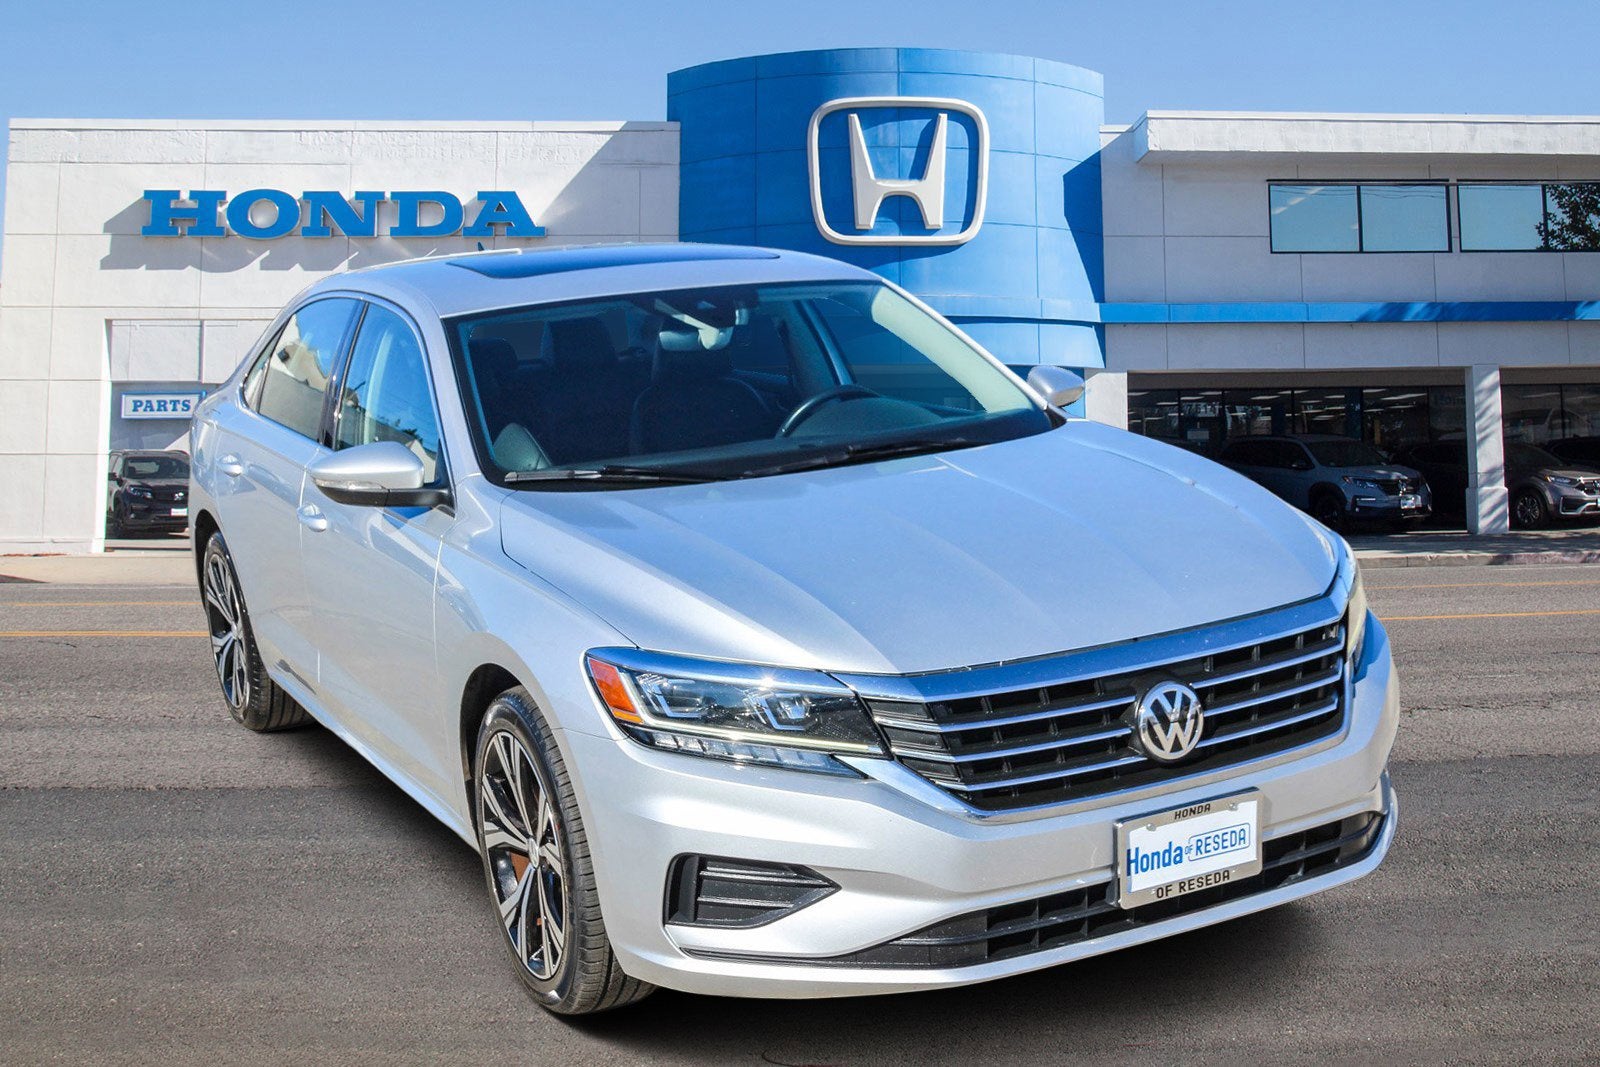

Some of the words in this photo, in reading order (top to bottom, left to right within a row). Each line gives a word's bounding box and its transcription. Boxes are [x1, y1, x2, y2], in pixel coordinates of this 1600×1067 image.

[141, 189, 546, 239] HONDA
[132, 400, 191, 412] PARTS
[1174, 803, 1211, 820] HONDA
[1127, 841, 1183, 876] Honda
[1195, 828, 1246, 856] RESEDA
[1156, 885, 1173, 899] OF
[1179, 870, 1230, 893] RESEDA
